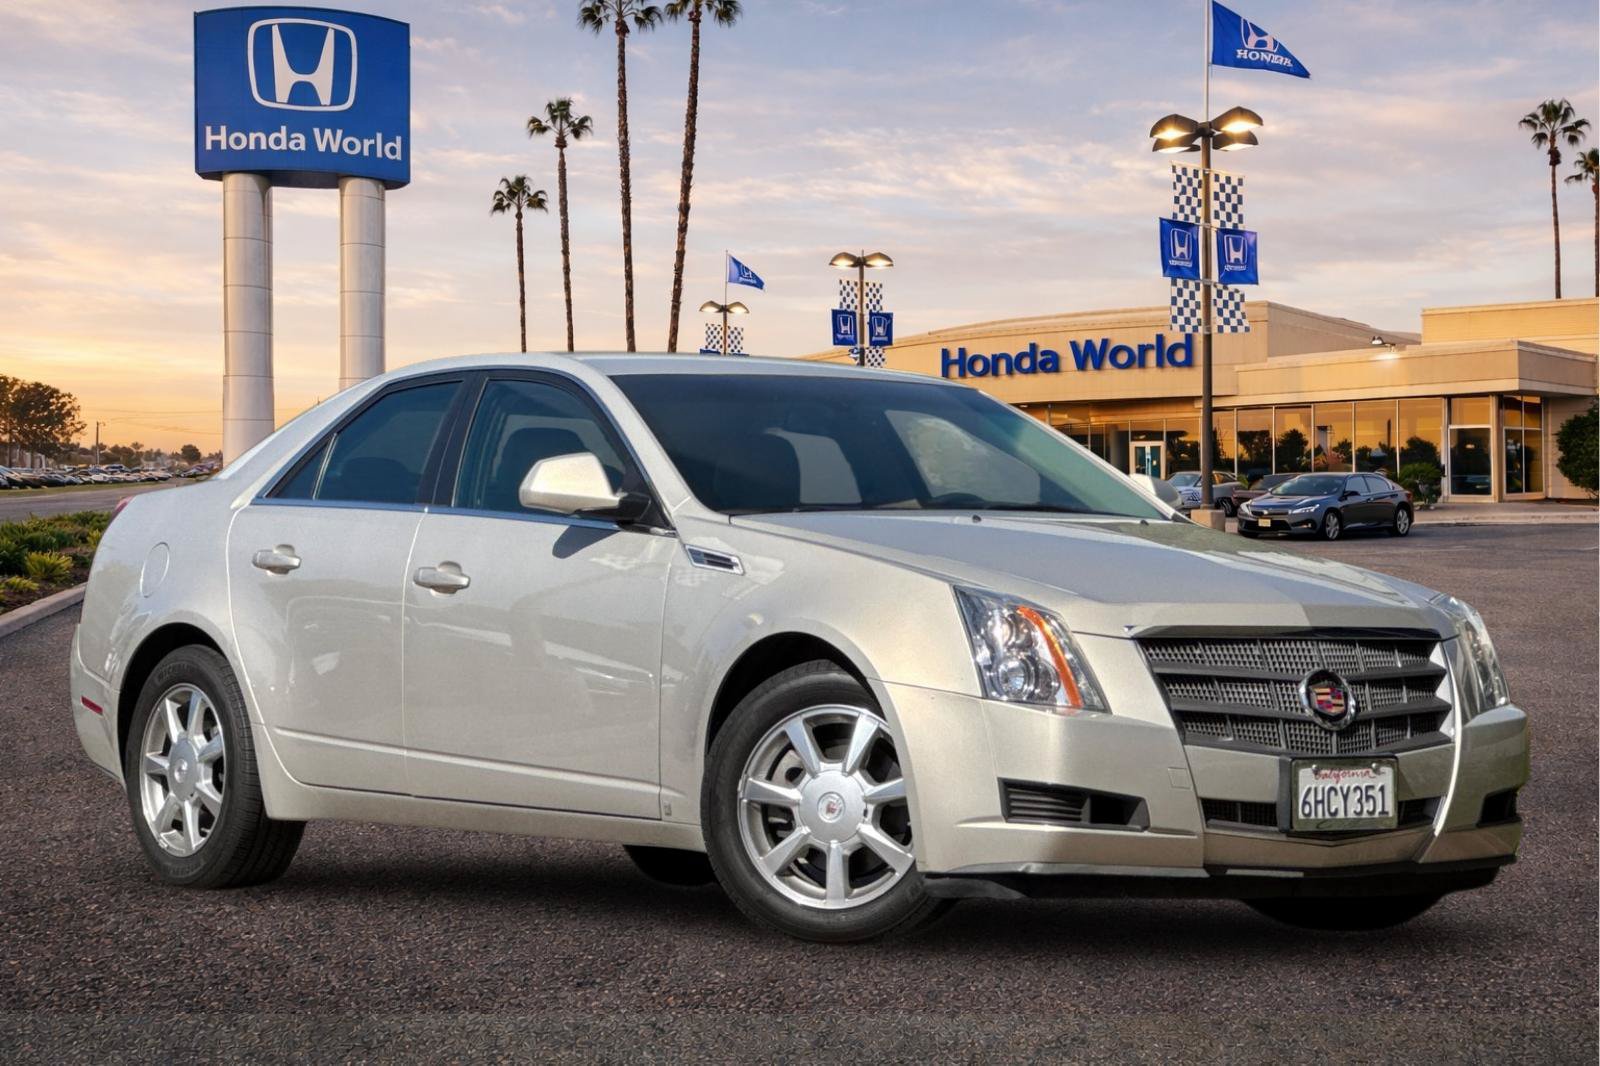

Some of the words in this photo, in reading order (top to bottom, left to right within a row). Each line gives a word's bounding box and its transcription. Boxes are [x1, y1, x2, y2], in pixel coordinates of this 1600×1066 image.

[205, 125, 306, 151] Honda
[313, 127, 402, 161] World
[941, 342, 1060, 379] Honda
[1069, 333, 1194, 371] World
[1301, 784, 1389, 818] 6HCY351
